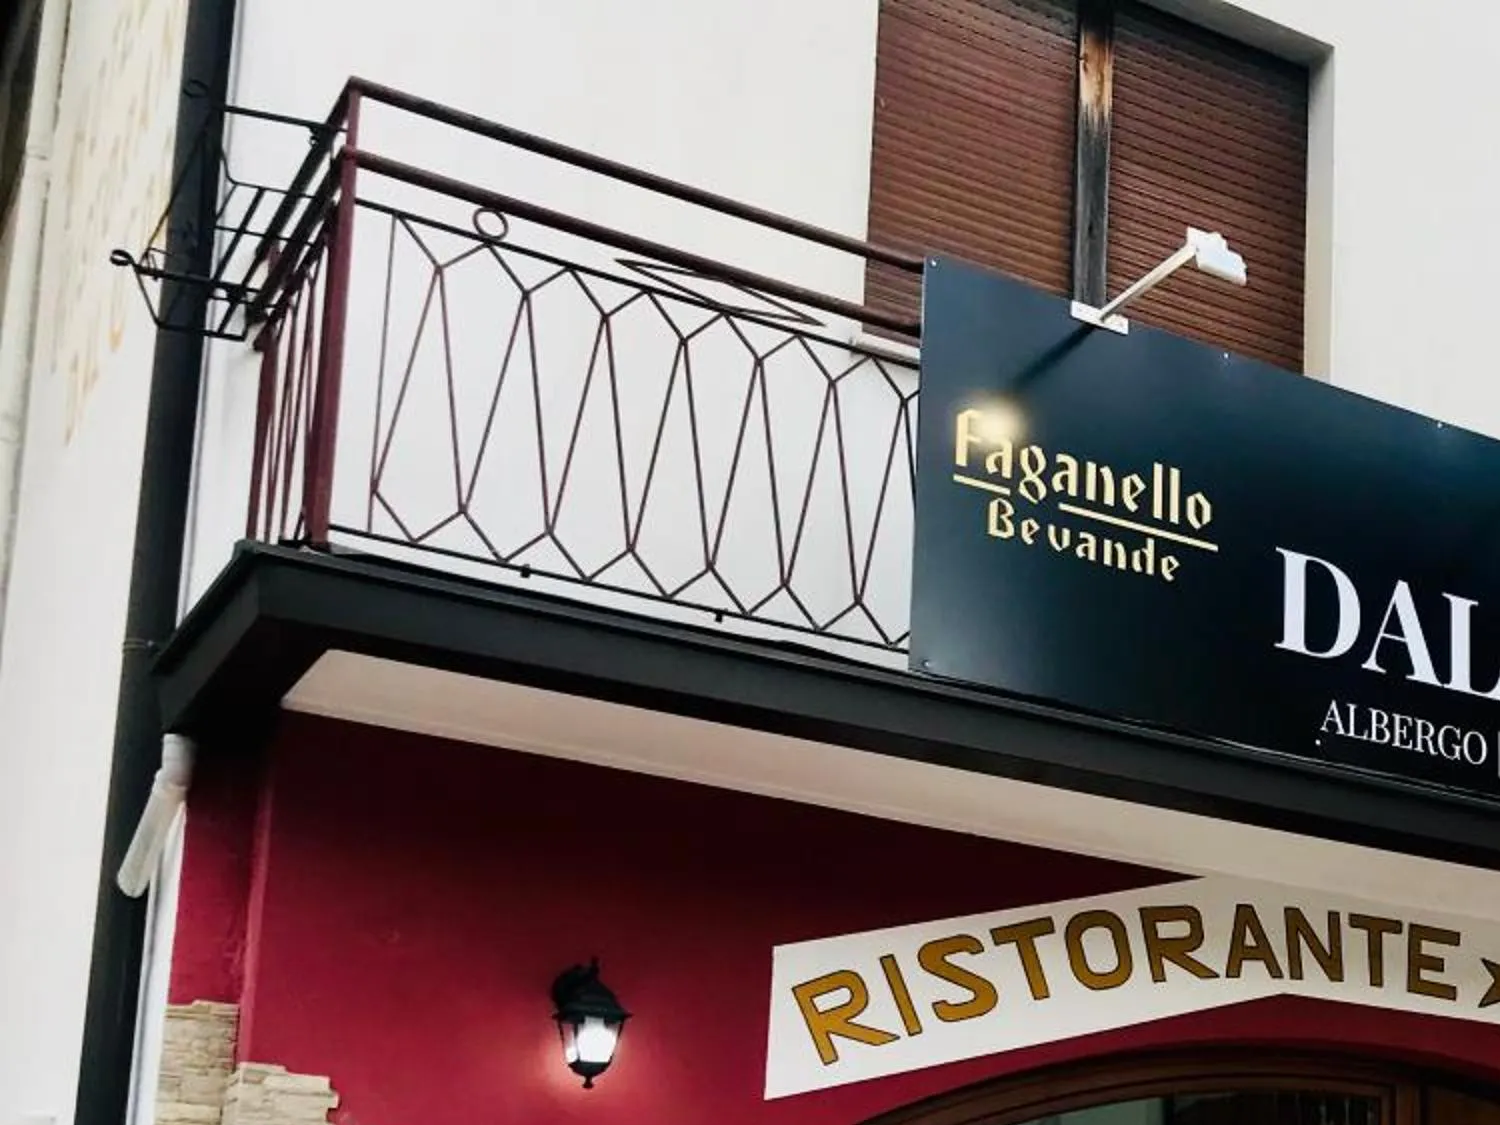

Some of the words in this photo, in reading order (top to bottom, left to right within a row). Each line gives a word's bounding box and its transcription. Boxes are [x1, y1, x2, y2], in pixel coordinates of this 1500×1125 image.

[987, 498, 1181, 582] Bevande
[1320, 700, 1488, 766] ALBERGO
[791, 903, 1461, 1066] RISTORANTE
